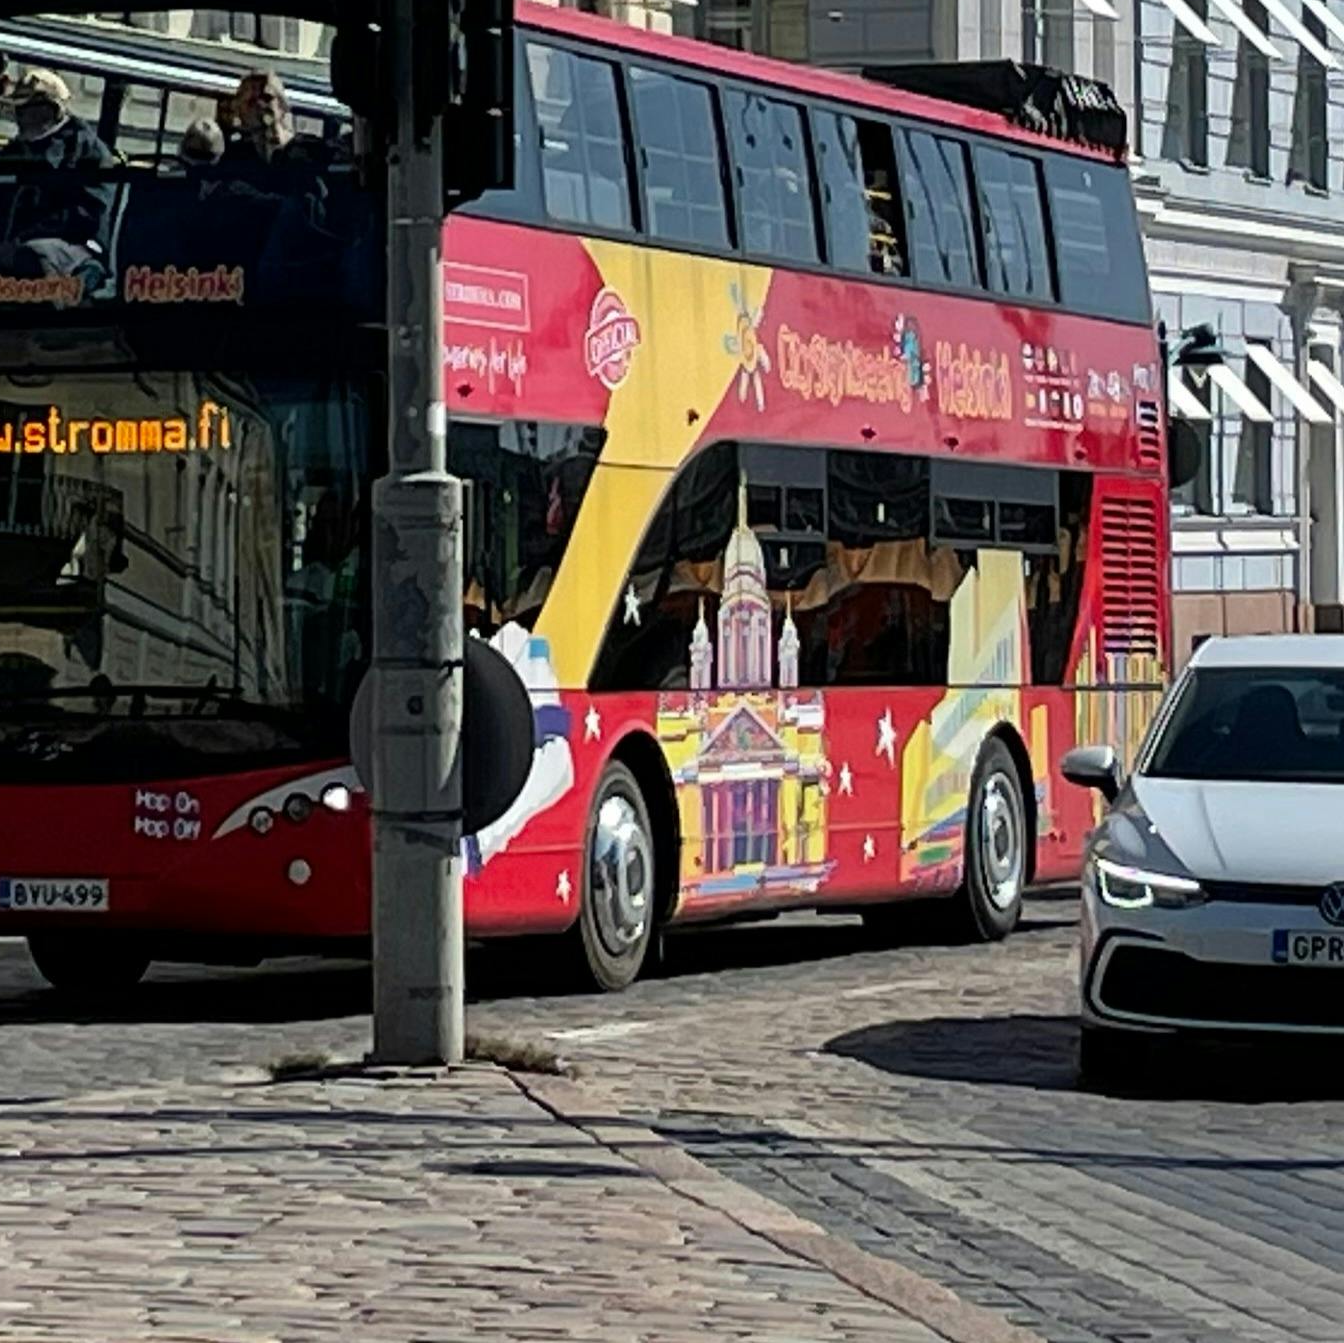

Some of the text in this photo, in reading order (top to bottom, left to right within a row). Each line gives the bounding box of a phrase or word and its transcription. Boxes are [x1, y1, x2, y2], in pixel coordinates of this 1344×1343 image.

[124, 265, 244, 303] Helsinki
[135, 788, 200, 813] Hop On
[134, 815, 202, 840] Hop Off
[14, 882, 104, 907] BYU-499
